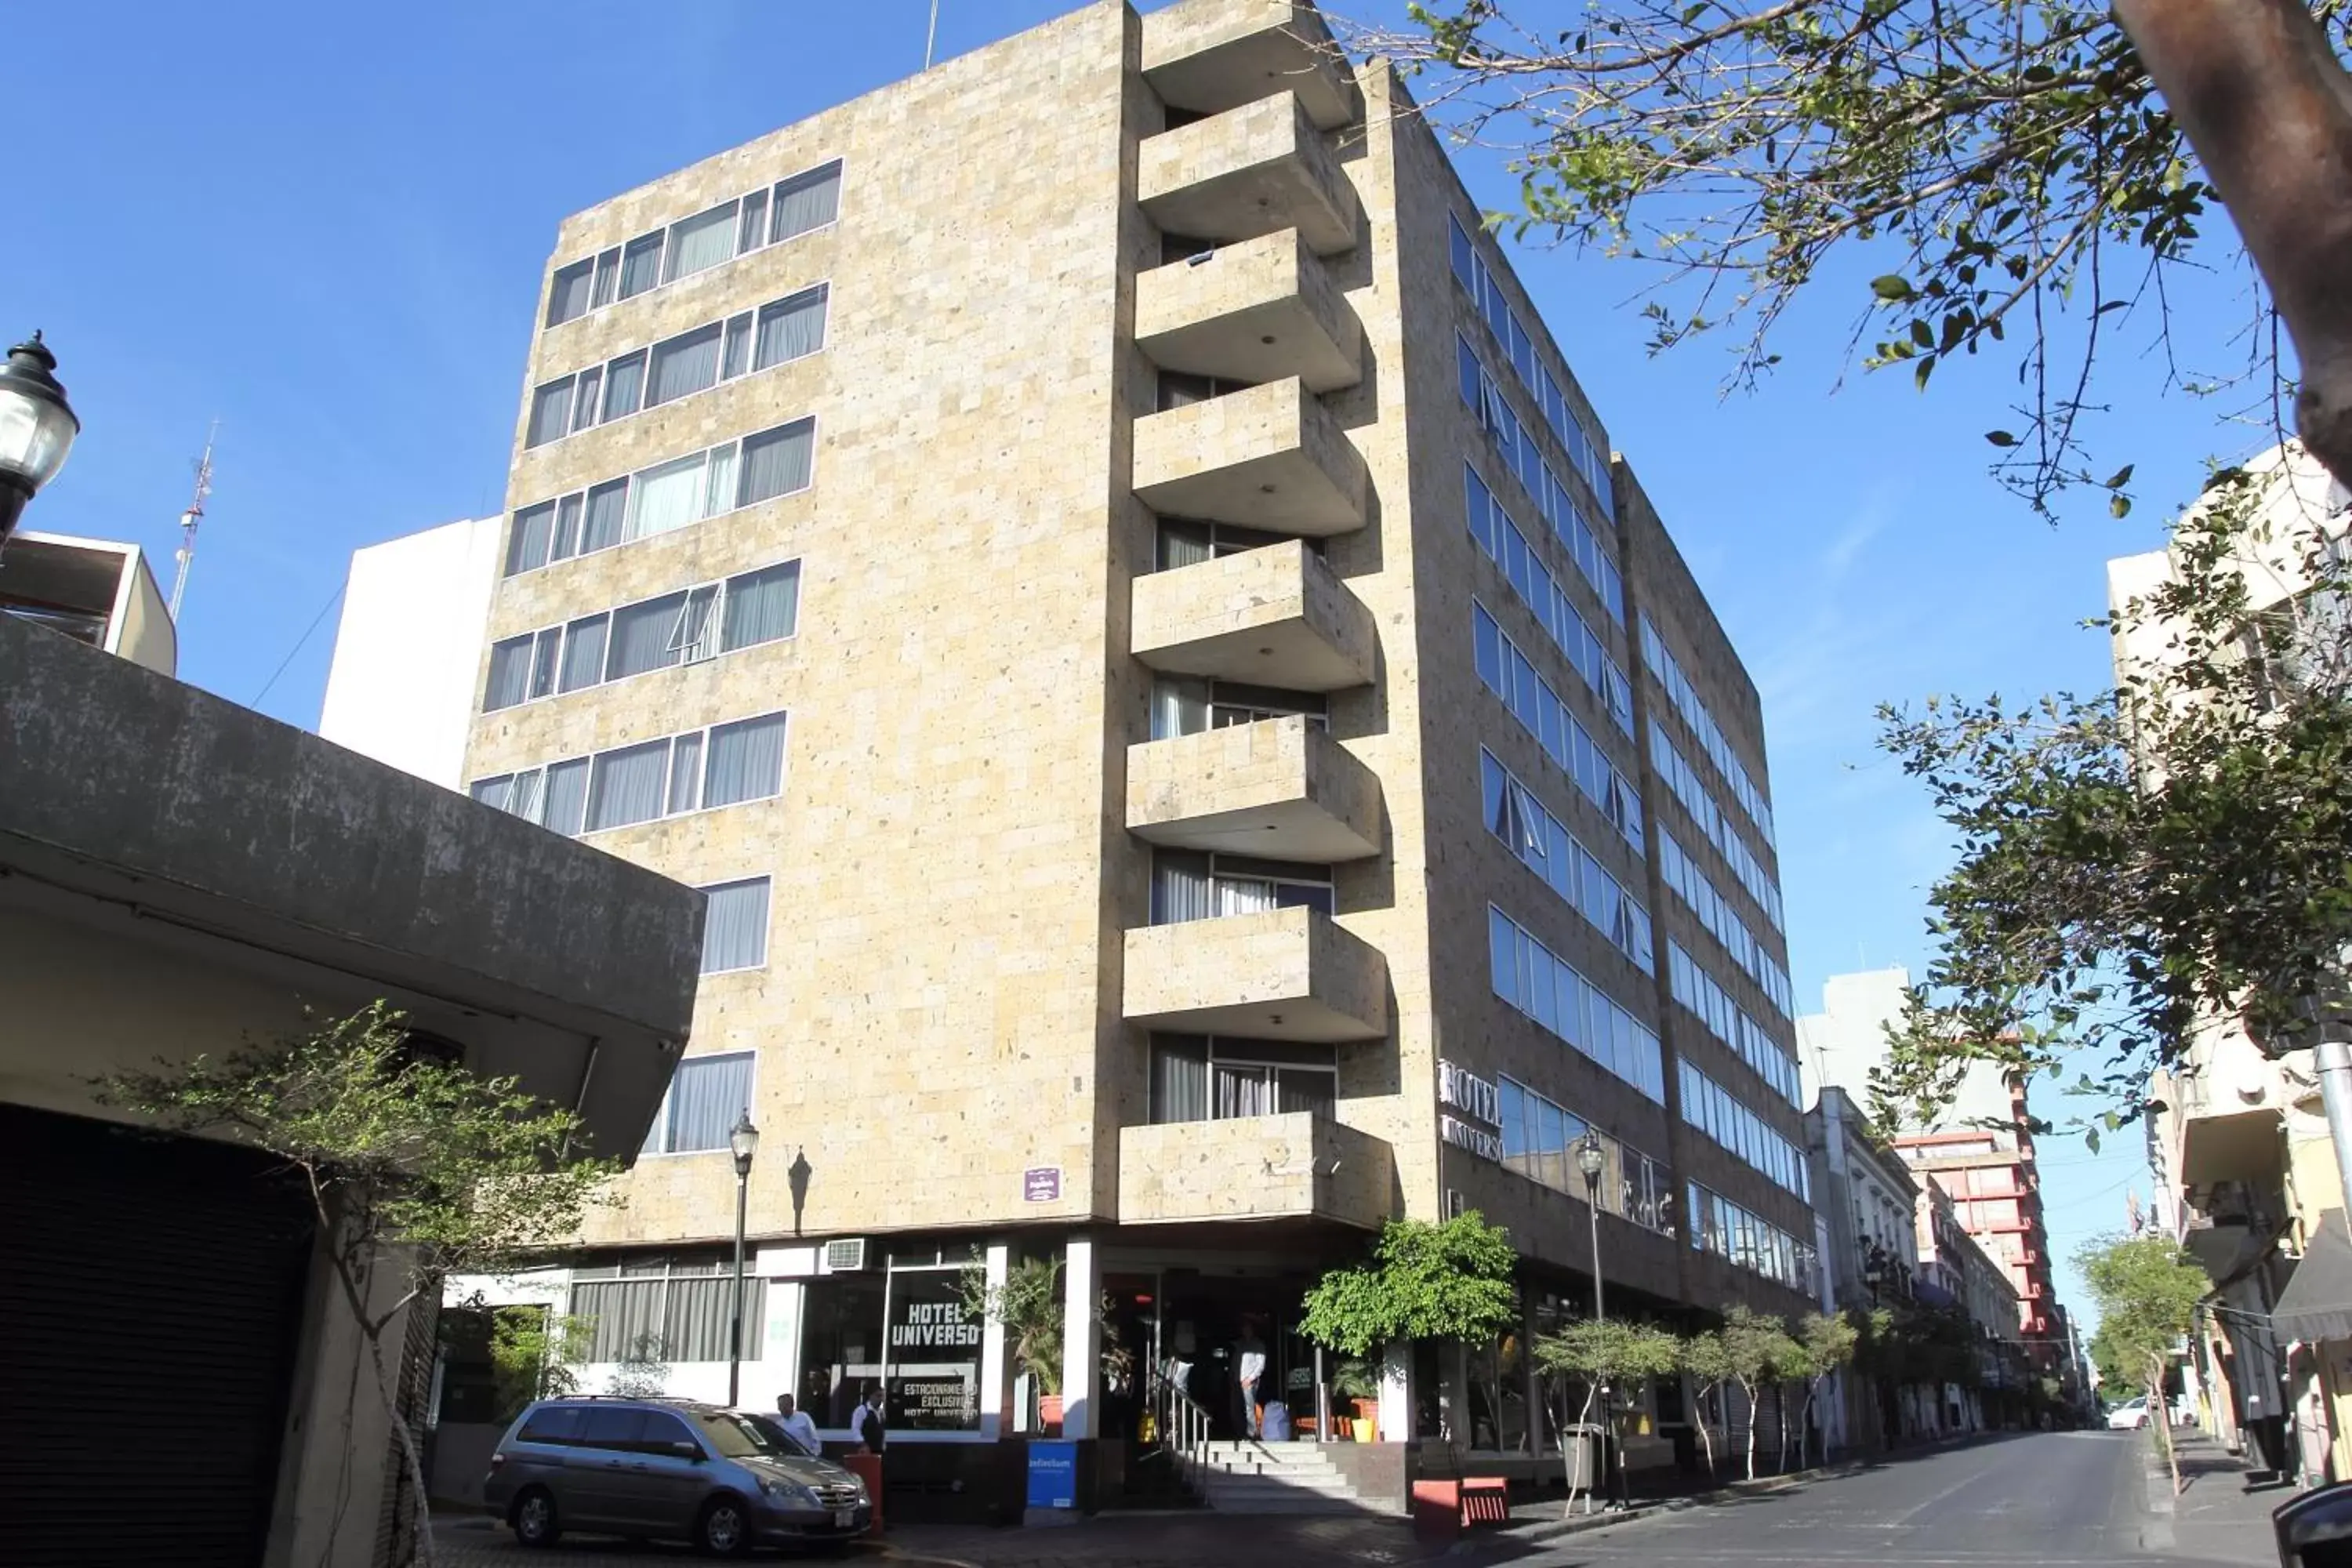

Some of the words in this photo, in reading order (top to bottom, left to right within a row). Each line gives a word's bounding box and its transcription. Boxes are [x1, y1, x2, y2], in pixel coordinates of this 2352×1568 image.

[1438, 1058, 1504, 1128] HOTEL
[1441, 1114, 1505, 1163] UNIVERSO
[909, 1303, 964, 1323] HOTEL
[891, 1324, 979, 1346] UNIVERSO
[904, 1383, 978, 1396] ESTACIONAMIEO
